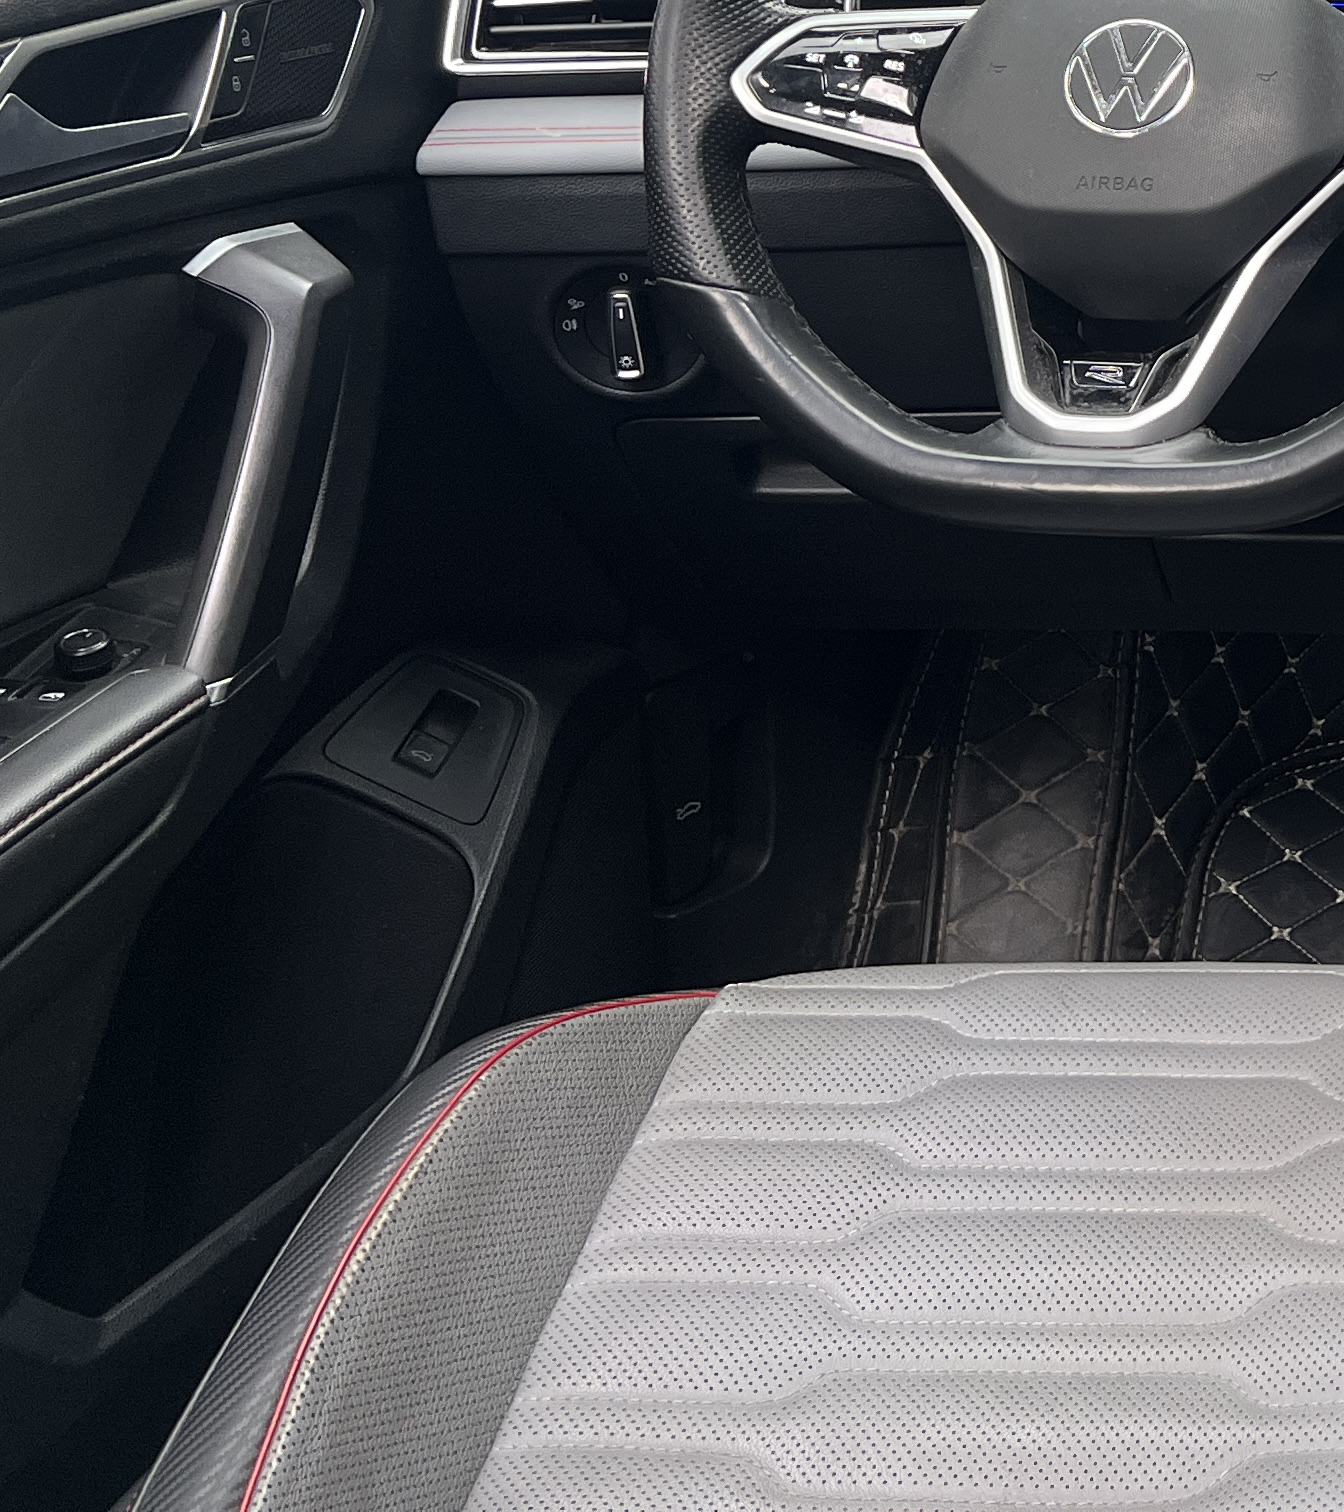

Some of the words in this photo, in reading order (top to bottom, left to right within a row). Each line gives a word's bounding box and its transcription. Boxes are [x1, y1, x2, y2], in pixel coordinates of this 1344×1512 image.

[805, 52, 826, 63] SET
[883, 58, 905, 73] RES
[1076, 174, 1154, 192] AIRBAG
